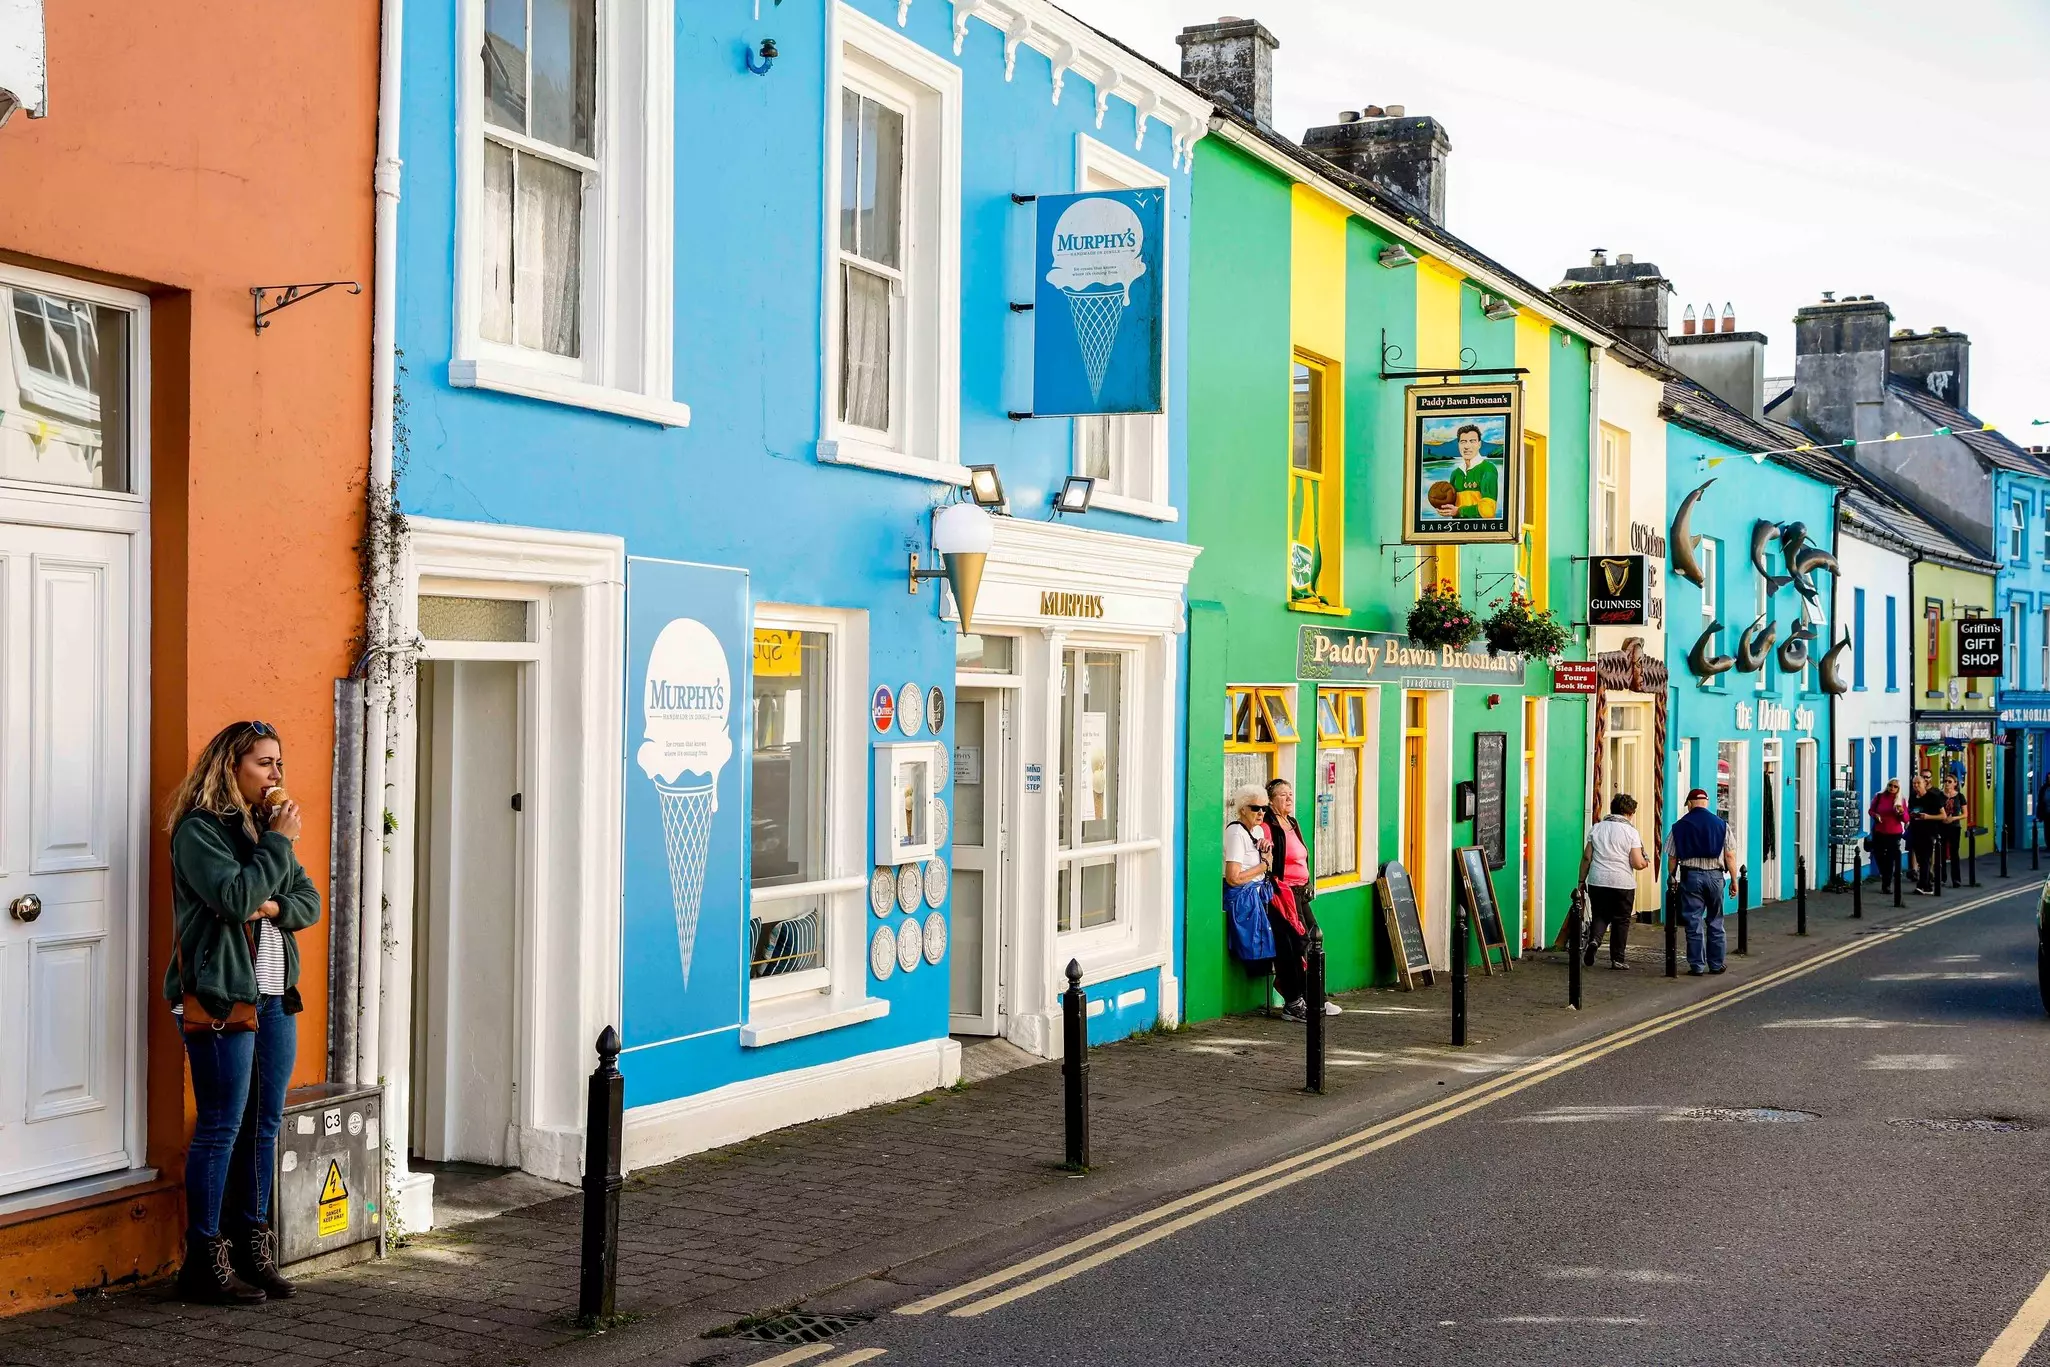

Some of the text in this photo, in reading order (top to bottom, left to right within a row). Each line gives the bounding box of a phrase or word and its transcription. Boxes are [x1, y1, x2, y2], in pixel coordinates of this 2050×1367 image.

[1421, 394, 1508, 408] Paddy Bawn Brosnan's
[1421, 521, 1504, 532] BAR & LOUNGE
[1590, 598, 1642, 610] GUINNESS
[1960, 623, 2001, 634] Griffin's
[1964, 638, 1995, 650] GIFT
[1313, 634, 1517, 675] Paddy Bawn Brosnan's
[1961, 654, 1999, 666] SHOP
[1735, 700, 1752, 731] the
[1794, 703, 1814, 738] shop
[1026, 783, 1041, 791] STEP
[325, 1114, 340, 1129] C3
[326, 1208, 342, 1217] DANGER
[323, 1215, 333, 1223] KEEP
